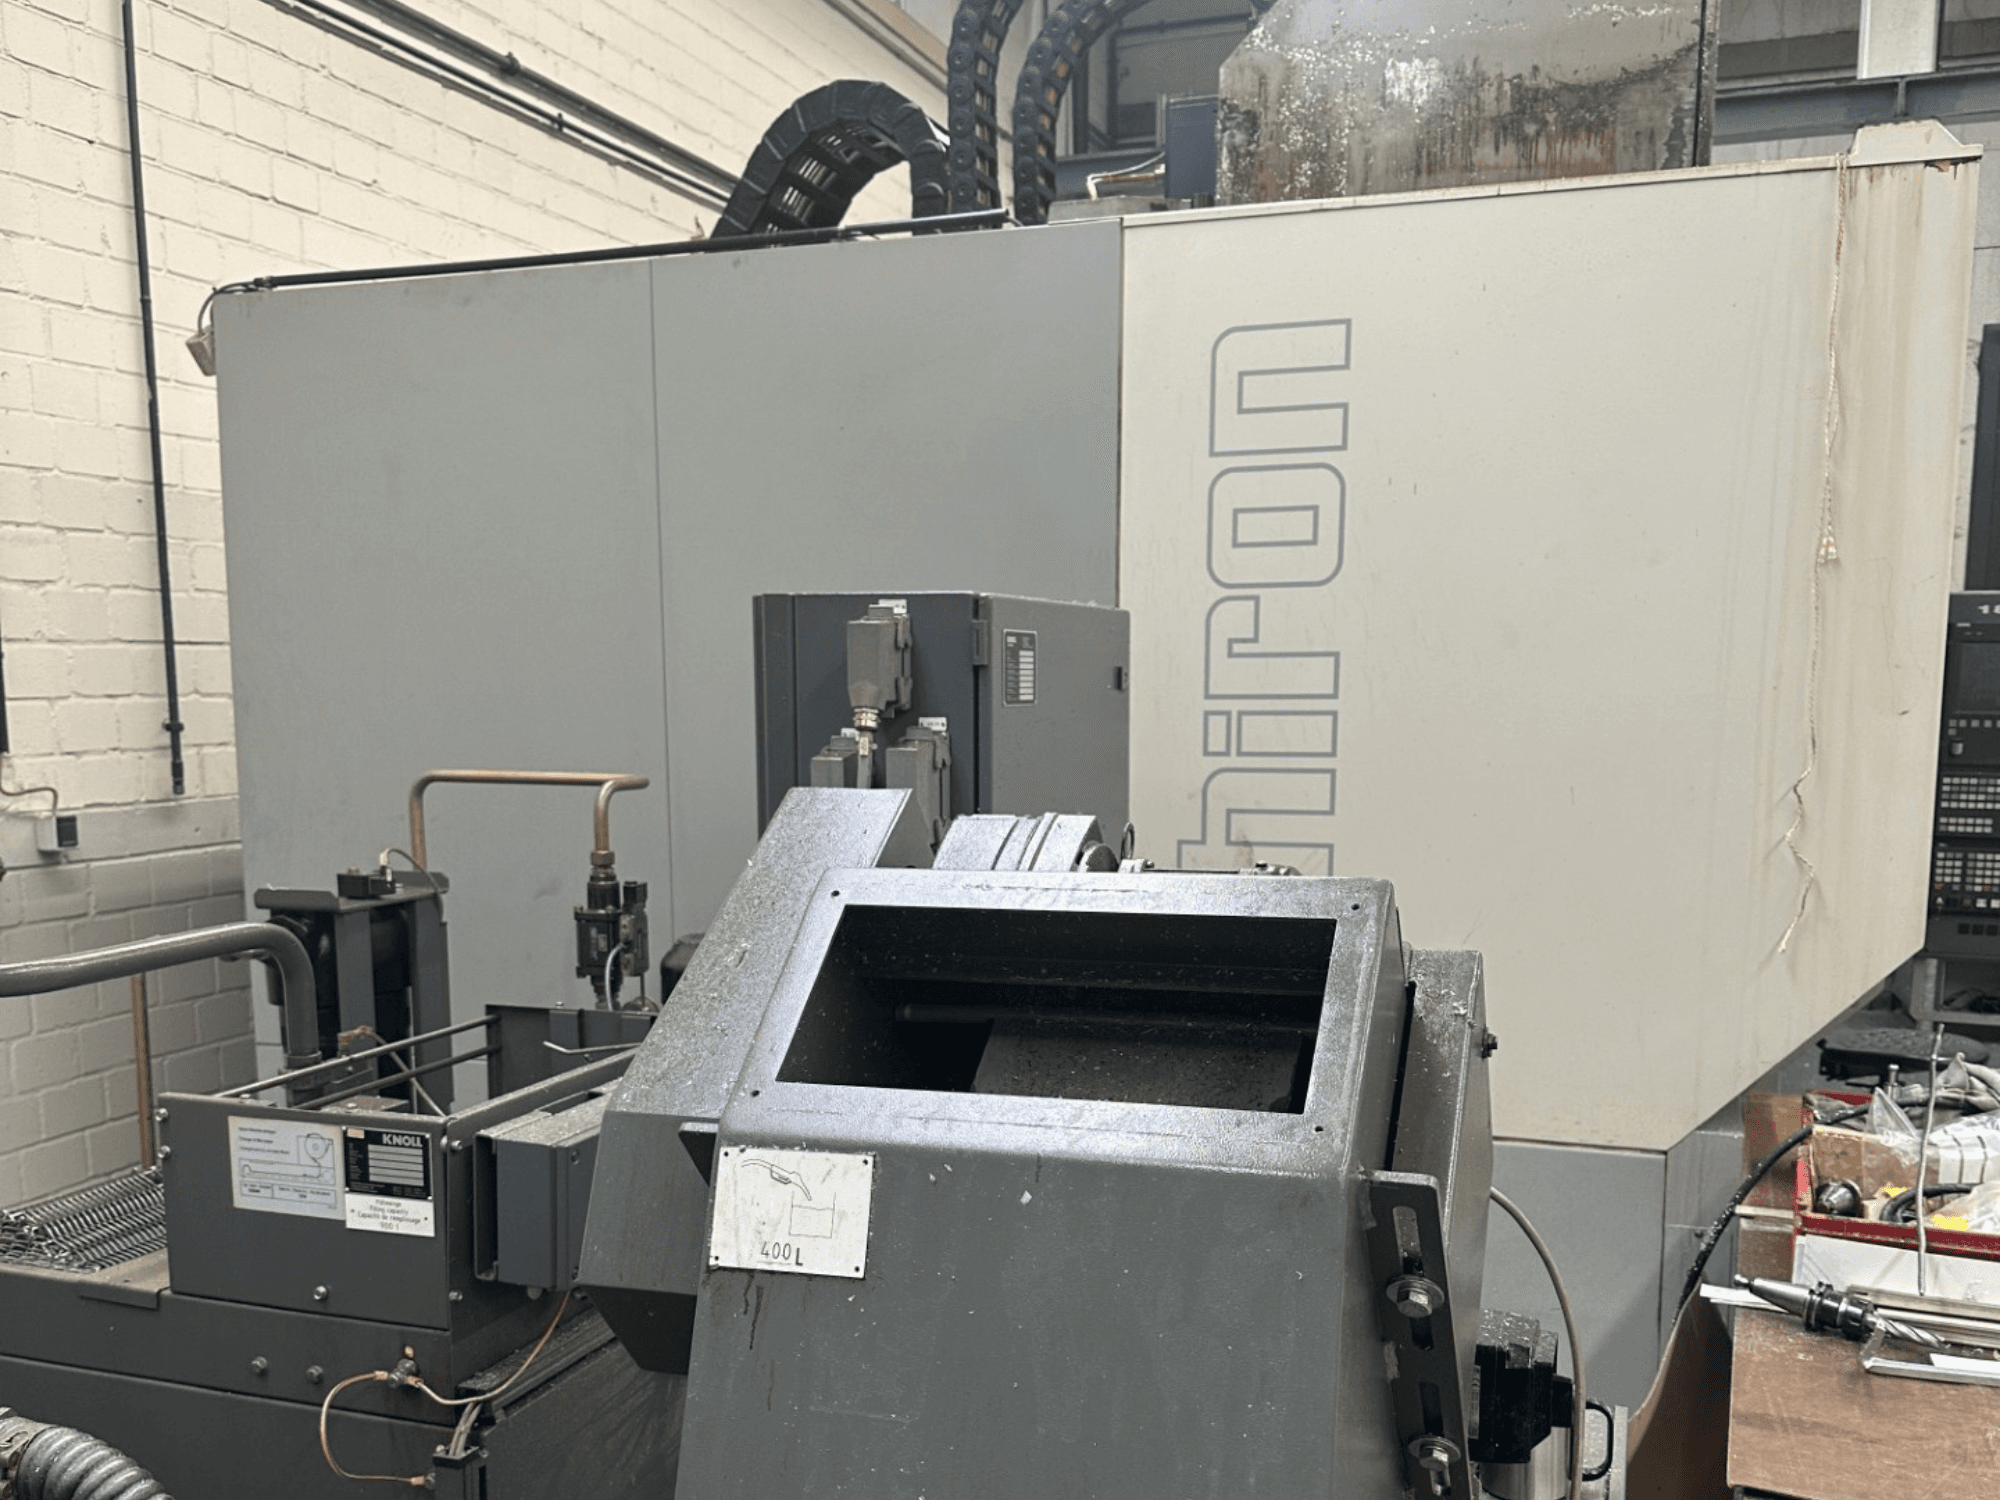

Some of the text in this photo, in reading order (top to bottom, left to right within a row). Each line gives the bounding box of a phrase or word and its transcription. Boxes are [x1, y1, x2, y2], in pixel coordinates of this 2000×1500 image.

[1177, 318, 1352, 877] hiron
[382, 1133, 423, 1148] KNOLL
[760, 1240, 804, 1267] 400 L
